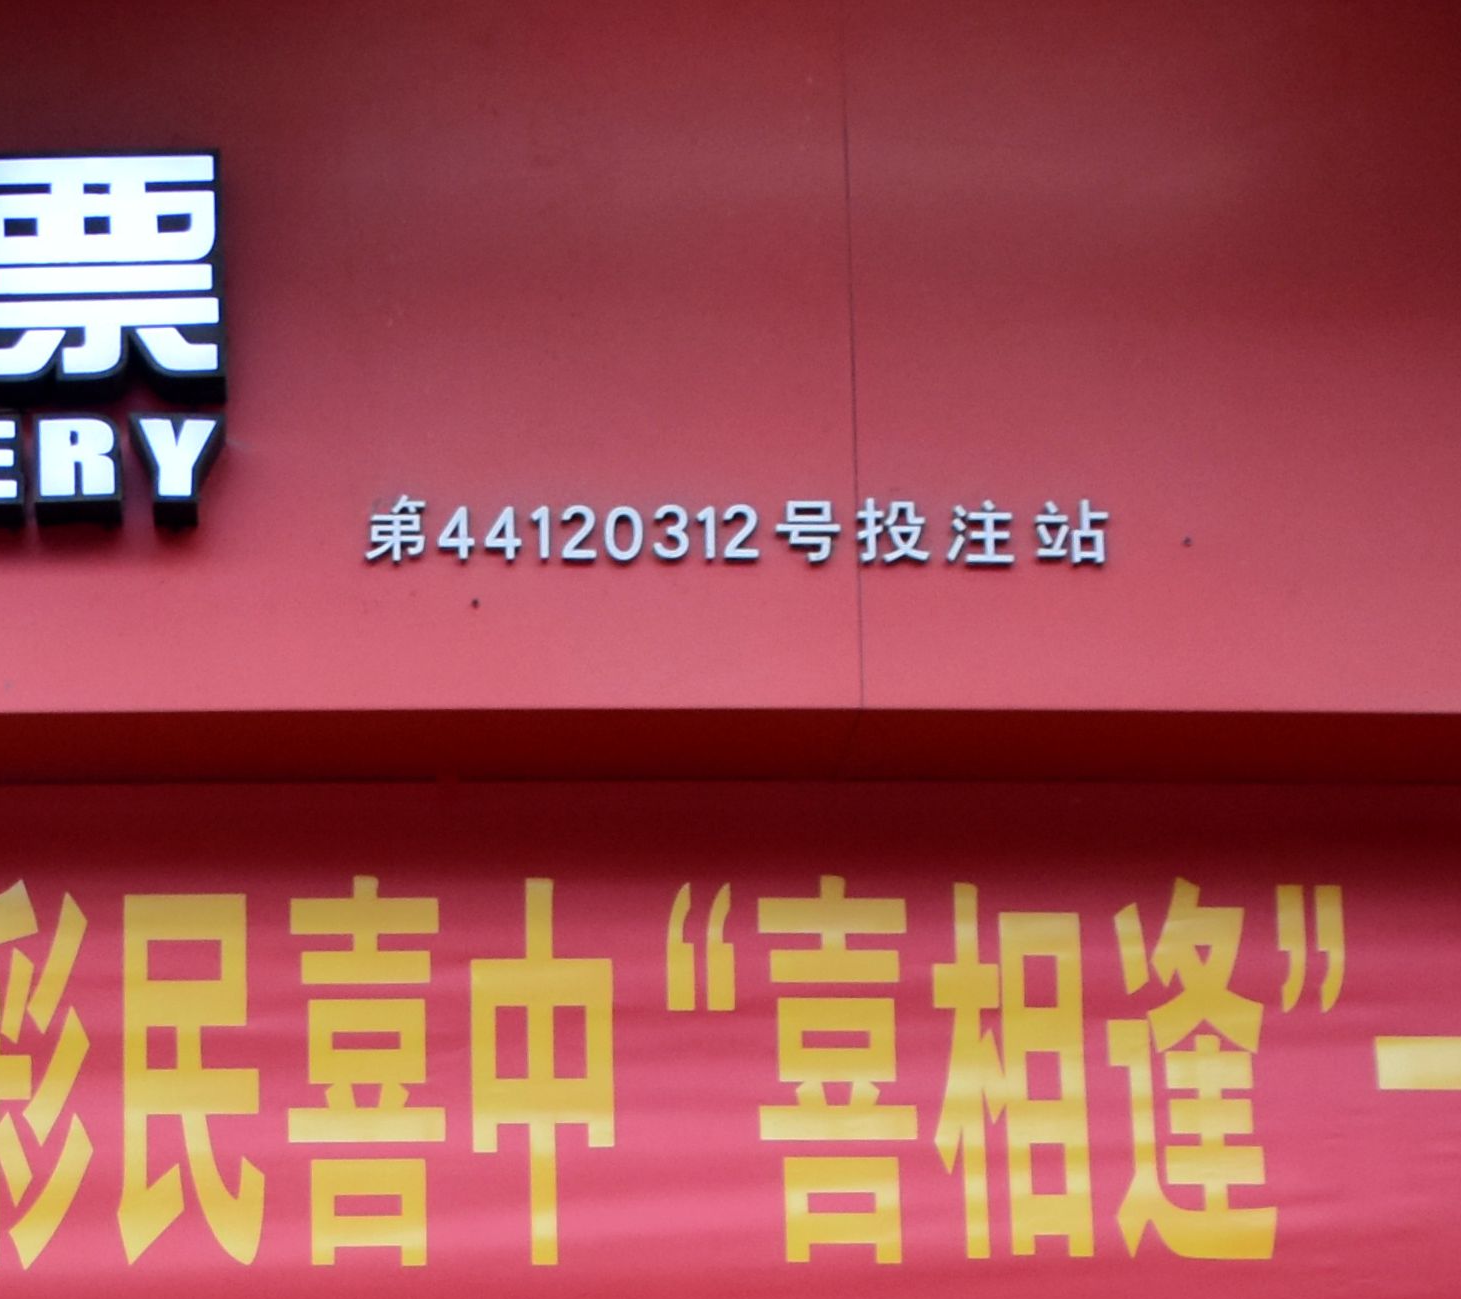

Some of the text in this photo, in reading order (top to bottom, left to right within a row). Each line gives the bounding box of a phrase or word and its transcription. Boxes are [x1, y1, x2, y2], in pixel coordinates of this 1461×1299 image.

[364, 492, 1112, 566] 第44120312号投注站
